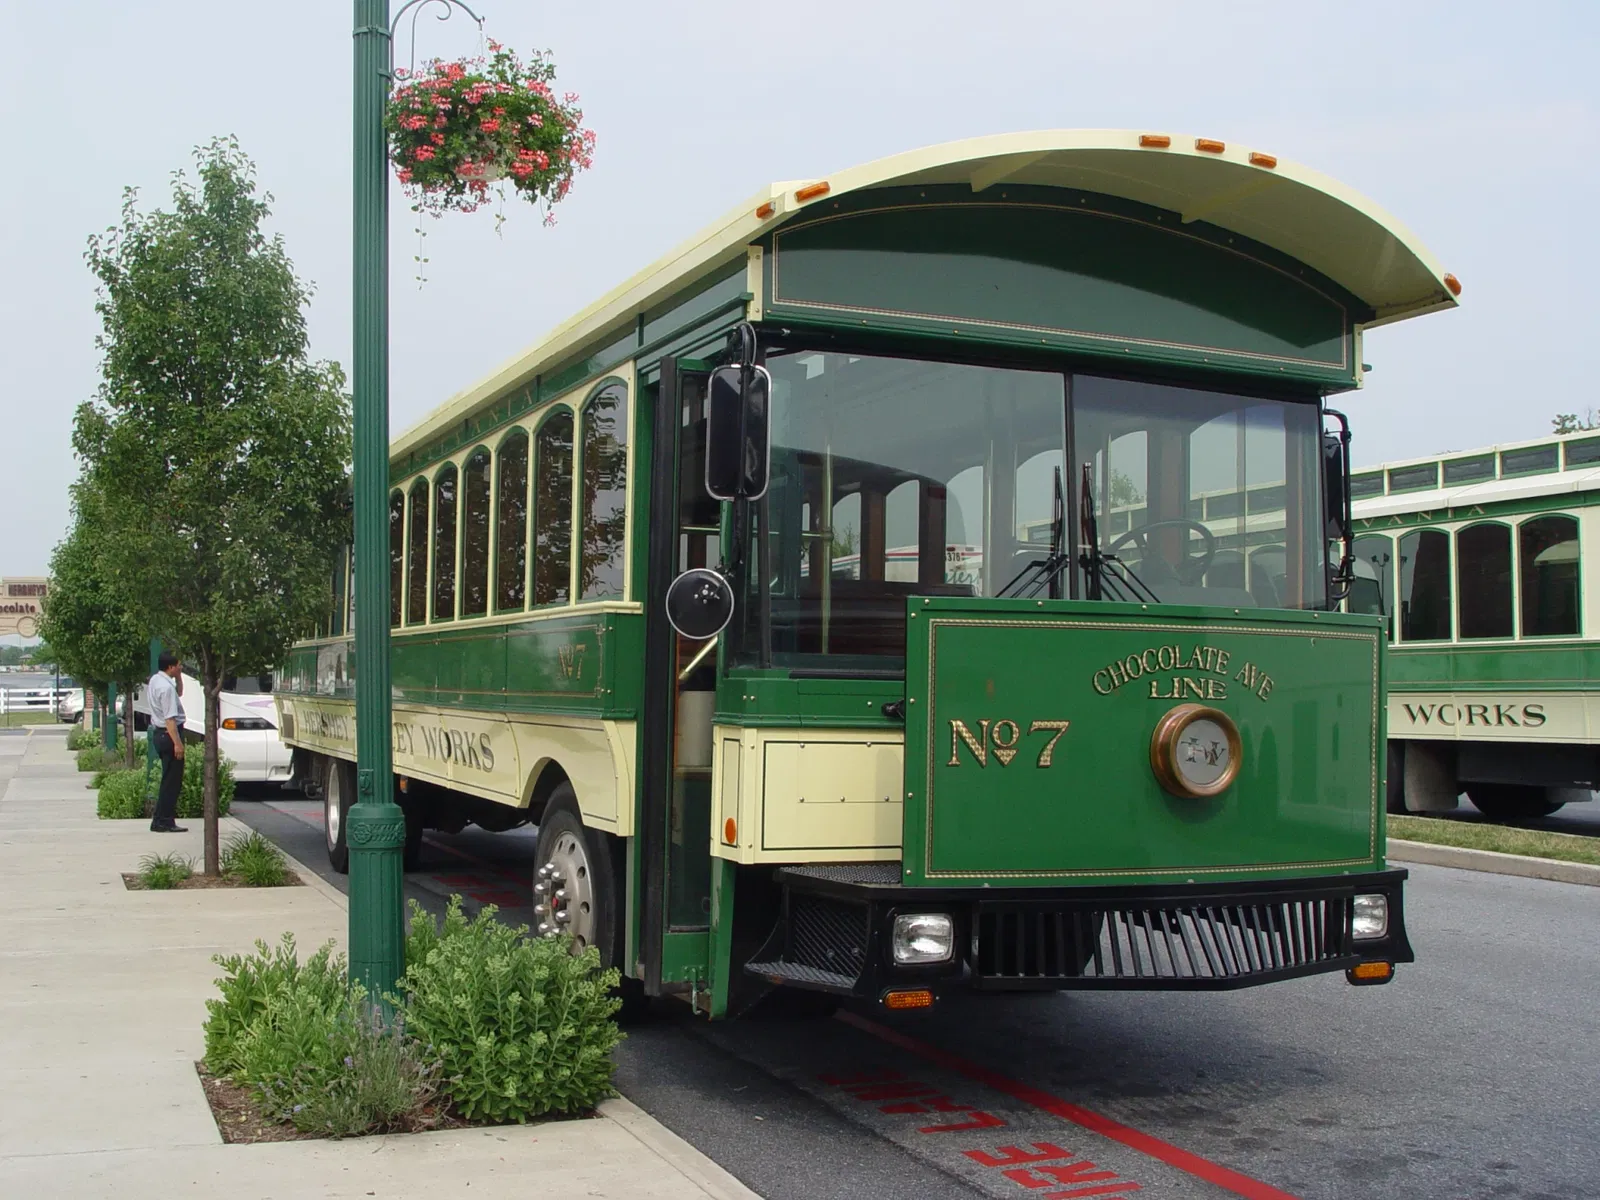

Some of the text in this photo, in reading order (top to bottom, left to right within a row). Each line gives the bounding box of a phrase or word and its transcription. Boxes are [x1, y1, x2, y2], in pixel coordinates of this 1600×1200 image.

[1092, 644, 1276, 701] CHOCOLATE AVE
[1150, 676, 1229, 700] LINE
[1403, 703, 1547, 728] WORKS
[421, 724, 495, 773] WORKS
[1027, 719, 1071, 768] 7
[962, 1142, 1144, 1200] IRE
